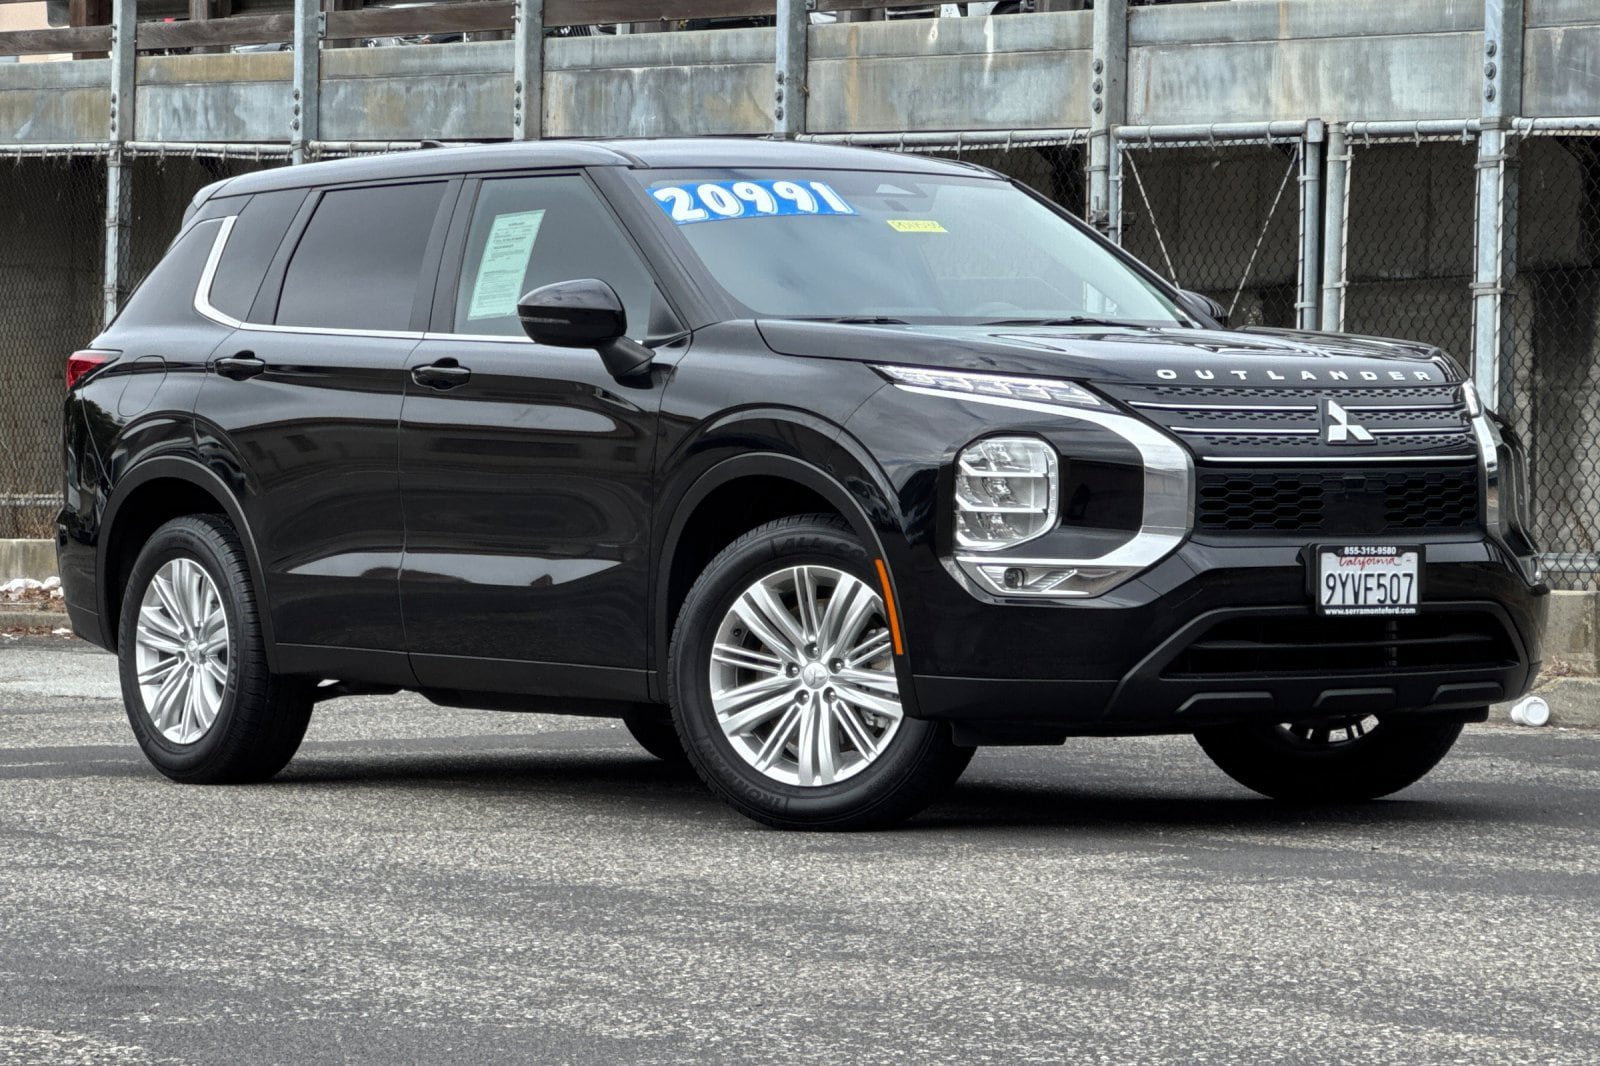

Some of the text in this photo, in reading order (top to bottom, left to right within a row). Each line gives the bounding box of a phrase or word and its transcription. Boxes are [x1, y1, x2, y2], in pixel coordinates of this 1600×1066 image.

[653, 181, 852, 221] 20991
[1156, 369, 1431, 381] OUTLANDER
[1344, 546, 1397, 555] 855-315-9580
[1338, 556, 1402, 570] California
[1325, 572, 1414, 605] 9YVF507
[1325, 606, 1416, 616] www.serramonteford.com
